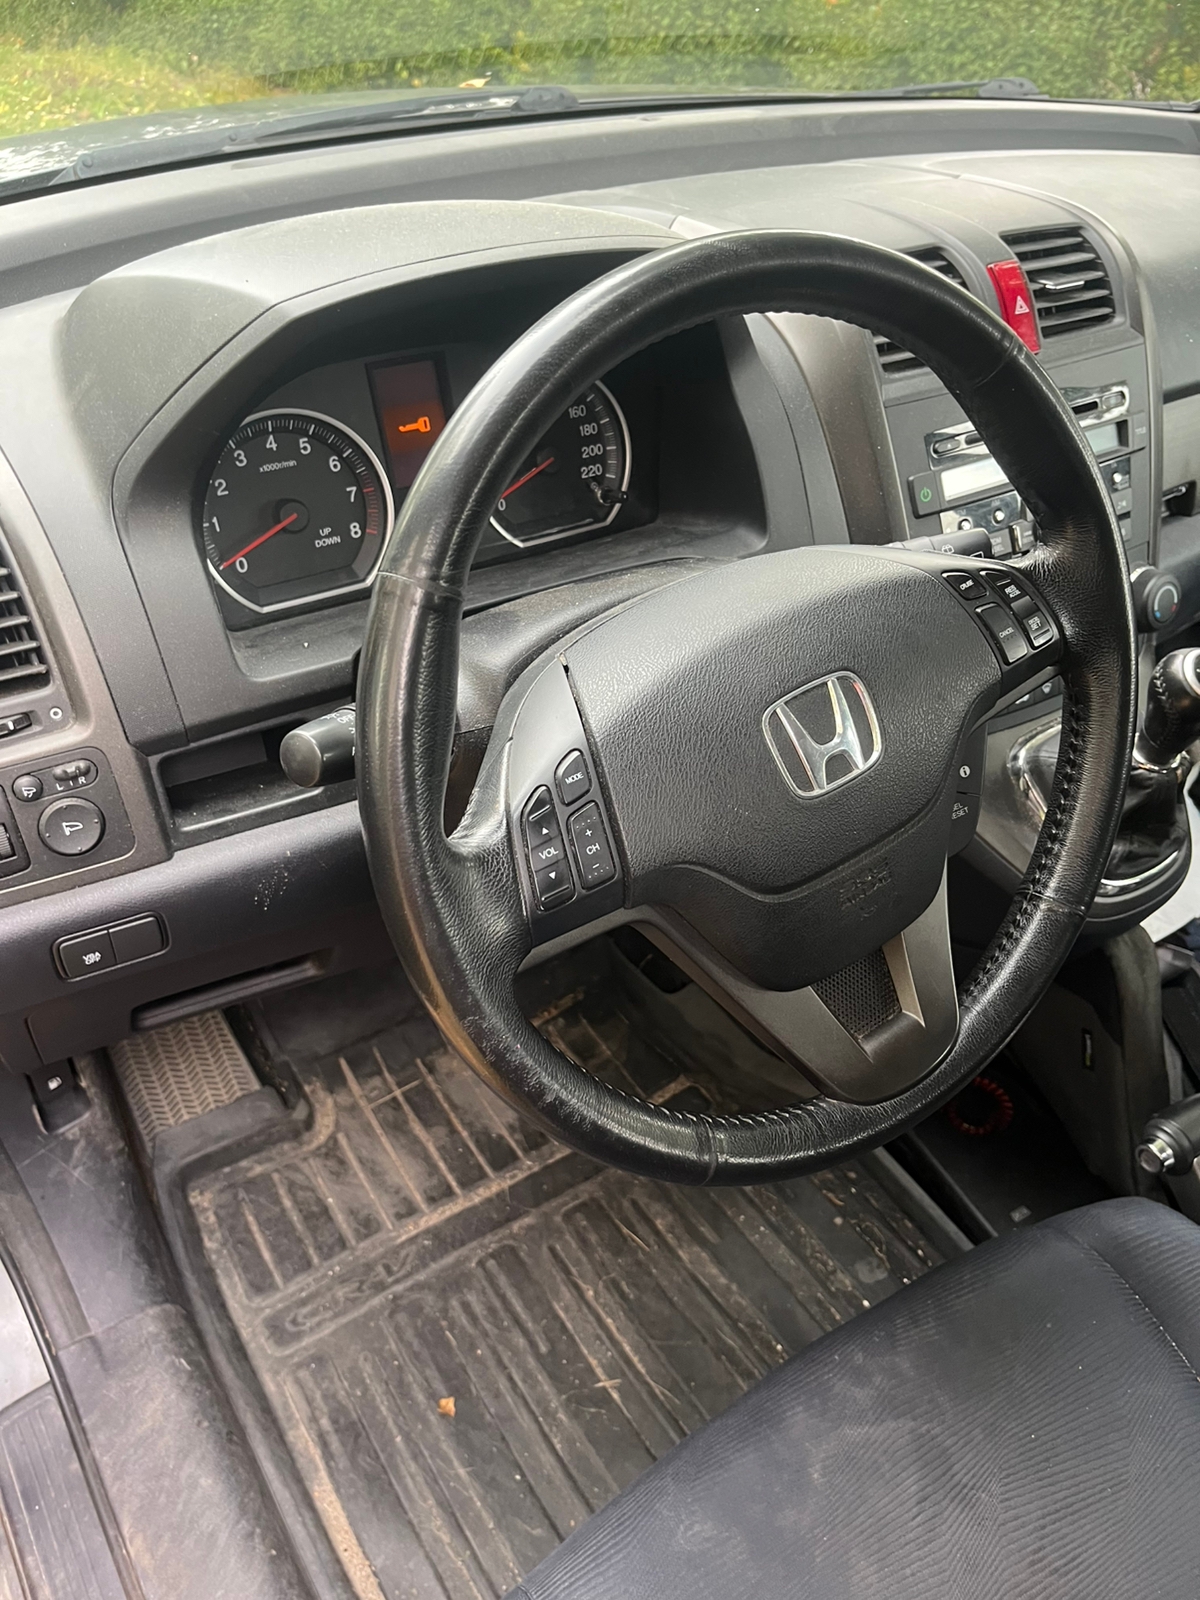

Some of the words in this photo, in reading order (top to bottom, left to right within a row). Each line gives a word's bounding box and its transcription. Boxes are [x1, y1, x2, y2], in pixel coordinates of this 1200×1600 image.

[568, 404, 586, 419] 160
[579, 423, 598, 437] 180
[265, 434, 278, 451] 4
[299, 438, 311, 455] 5
[581, 443, 604, 458] 200
[233, 450, 247, 467] 3
[259, 459, 298, 473] x1000r/min
[328, 455, 341, 472] 6
[580, 464, 603, 479] 220
[214, 479, 229, 496] 2
[346, 486, 357, 502] 7
[497, 499, 507, 511] 0
[211, 516, 221, 532] 1
[349, 522, 362, 538] 8
[319, 527, 332, 537] UP
[315, 535, 341, 548] DOWN
[235, 557, 248, 573] 0
[56, 782, 64, 791] L
[77, 776, 87, 785] R
[564, 771, 585, 785] MODE
[538, 847, 559, 860] VOL
[586, 843, 601, 856] CH
